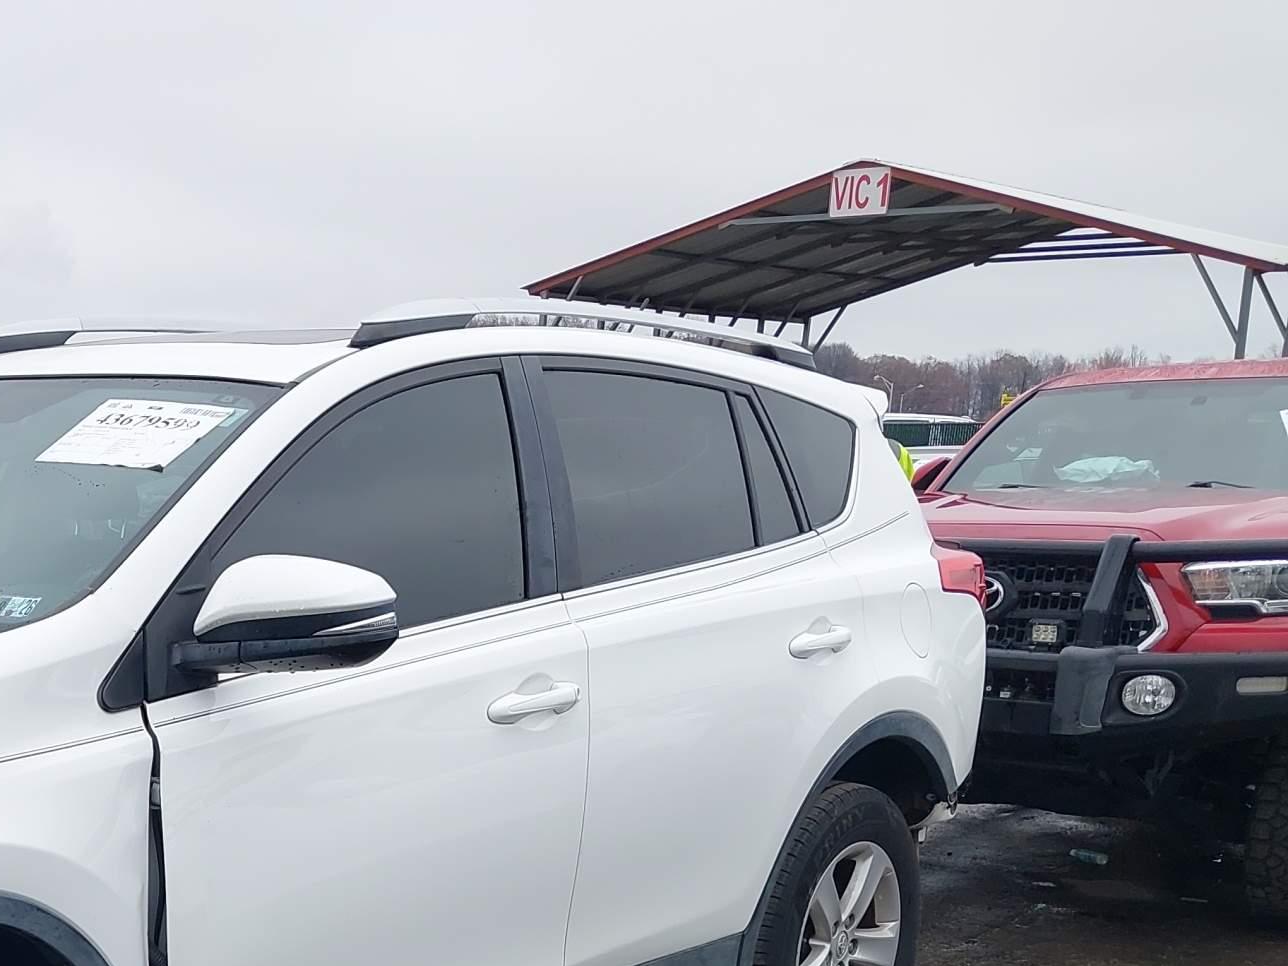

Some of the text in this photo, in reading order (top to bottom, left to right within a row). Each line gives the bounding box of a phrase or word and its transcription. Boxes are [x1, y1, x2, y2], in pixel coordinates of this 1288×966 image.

[834, 173, 889, 210] VIC 1
[95, 413, 201, 431] 43679599
